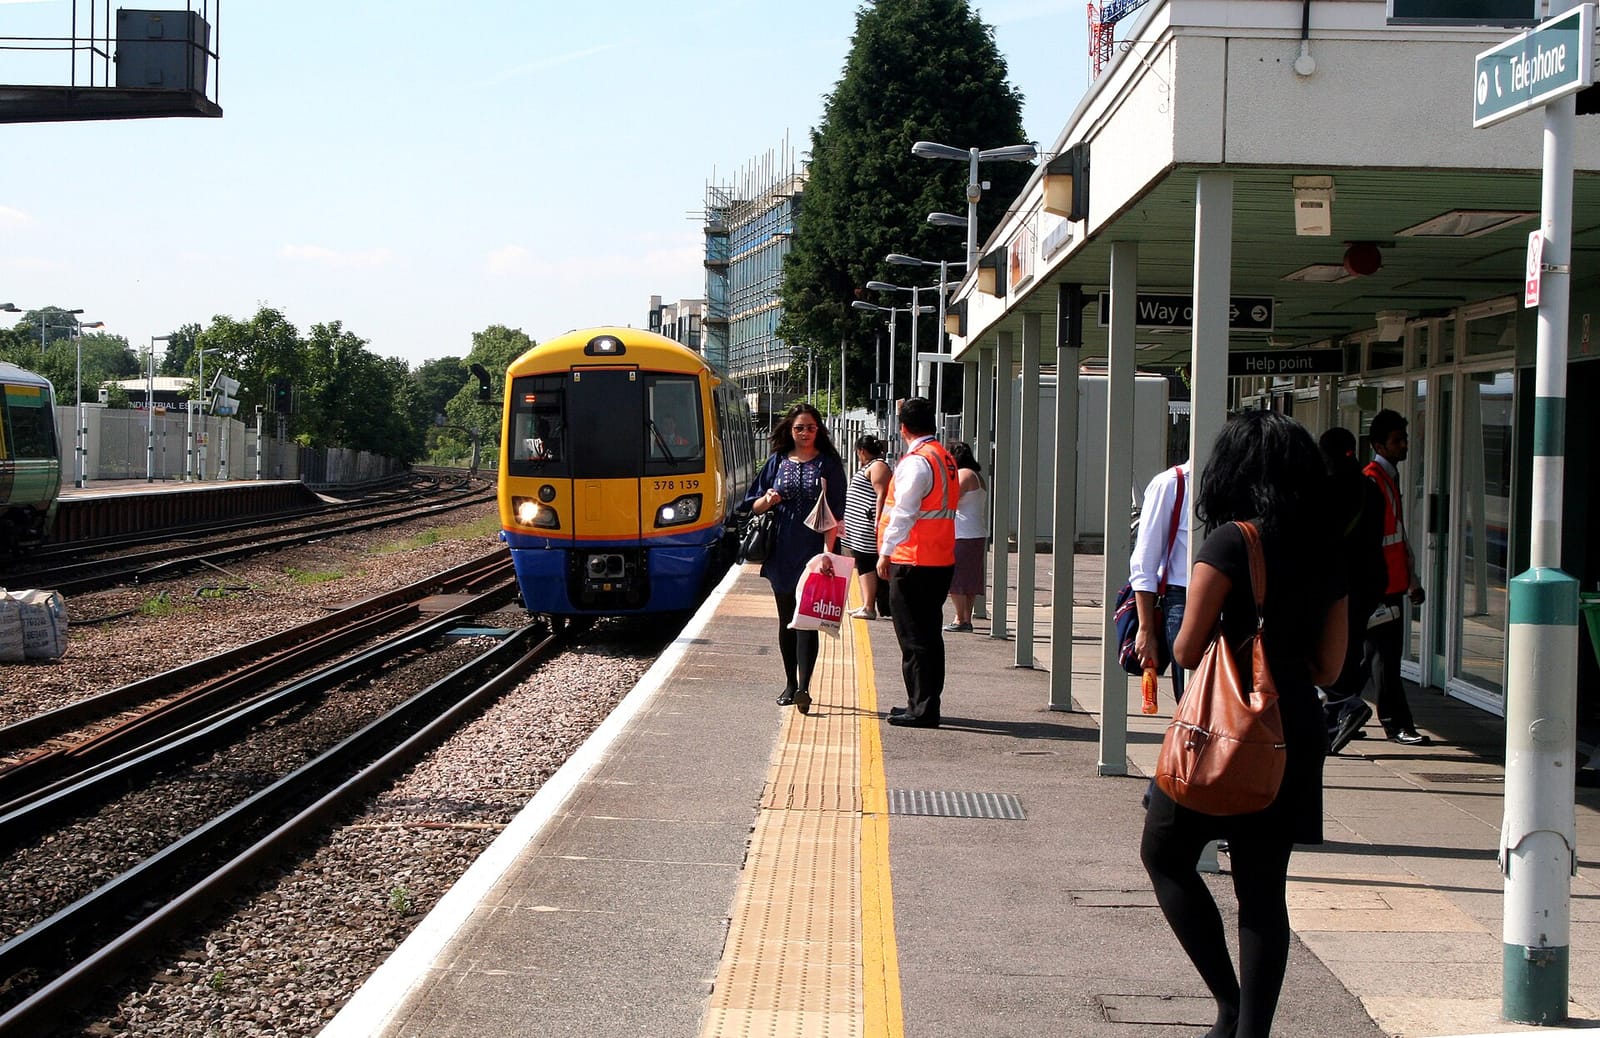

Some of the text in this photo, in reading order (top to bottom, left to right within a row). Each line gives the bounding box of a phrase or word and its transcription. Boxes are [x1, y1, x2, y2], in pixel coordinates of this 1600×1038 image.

[1510, 44, 1566, 94] Telephone
[1140, 302, 1178, 324] Way
[1246, 357, 1313, 373] Help point
[877, 386, 881, 397] 1
[654, 480, 699, 490] 378 139
[813, 599, 841, 618] alpha
